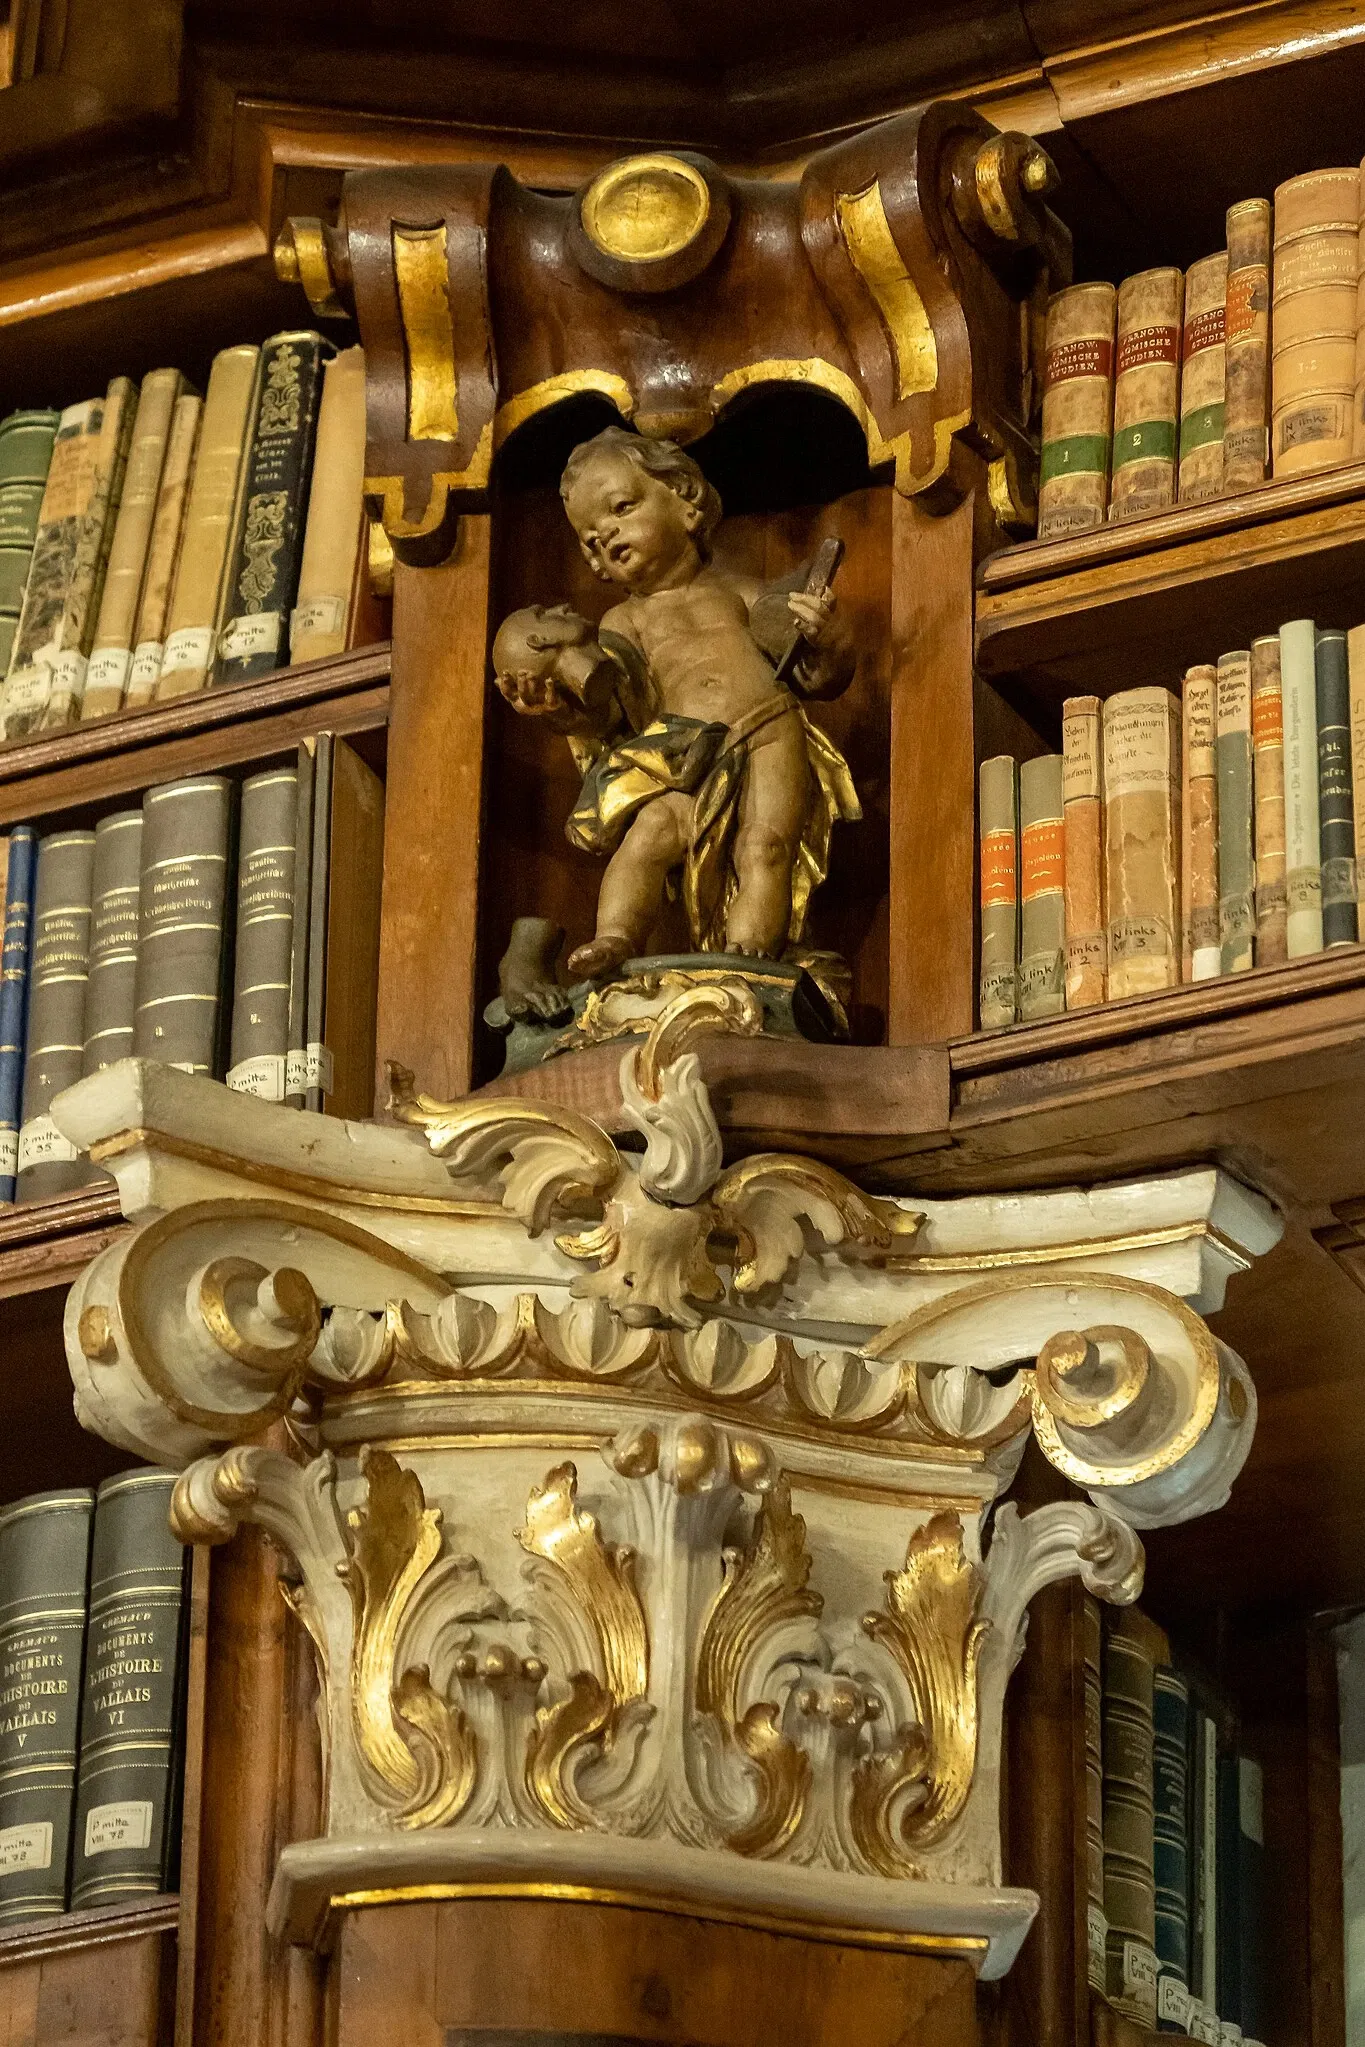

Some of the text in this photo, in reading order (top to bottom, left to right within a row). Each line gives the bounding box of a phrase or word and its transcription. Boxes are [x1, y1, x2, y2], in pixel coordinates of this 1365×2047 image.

[1192, 309, 1224, 328] FERNO
[1189, 320, 1225, 341] RÖMISC
[1192, 331, 1225, 349] STUDIE
[1120, 350, 1166, 368] STUDIEN.
[1050, 362, 1097, 380] STUDIEN.
[1204, 416, 1213, 428] 3
[1299, 416, 1328, 426] links
[1132, 433, 1142, 447] 2
[1228, 436, 1255, 449] links
[1063, 450, 1069, 463] 1
[1123, 502, 1151, 514] links
[1055, 517, 1085, 528] links
[1113, 926, 1156, 942] N links
[1069, 943, 1101, 957] links
[1137, 938, 1146, 948] 3
[1080, 956, 1091, 965] 2
[238, 1073, 268, 1087] mitte
[31, 1131, 60, 1143] mitte
[97, 1631, 154, 1656] DOCUMENTS
[4, 1654, 63, 1677] DOCUMENTS
[90, 1659, 162, 1686] L'HISTOIRE
[93, 1687, 151, 1713] VALLAIS
[108, 1710, 125, 1726] VI
[17, 1733, 27, 1748] V
[93, 1818, 129, 1831] P mitte
[109, 1829, 125, 1839] 78
[1131, 1955, 1138, 1965] P
[1166, 1988, 1174, 1999] P
